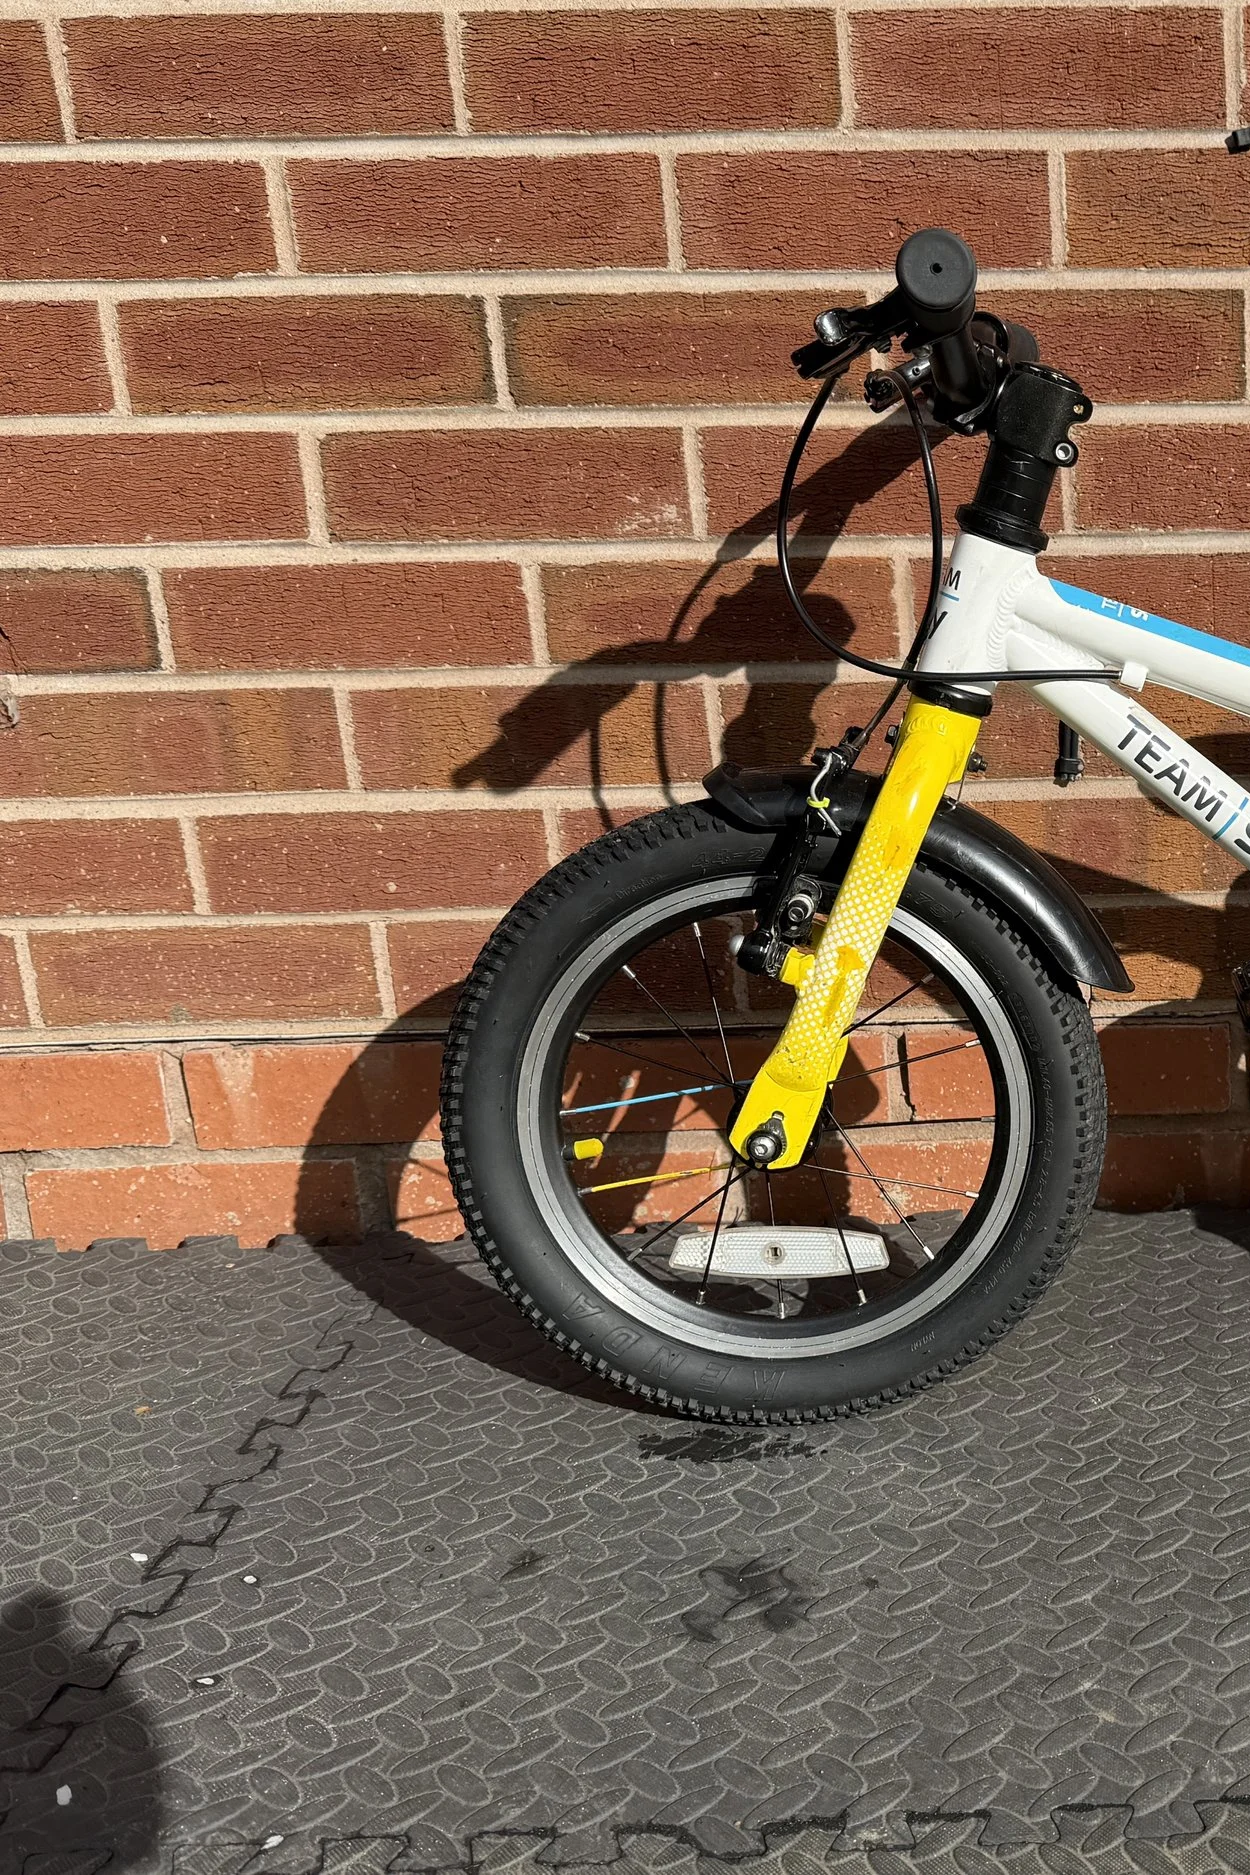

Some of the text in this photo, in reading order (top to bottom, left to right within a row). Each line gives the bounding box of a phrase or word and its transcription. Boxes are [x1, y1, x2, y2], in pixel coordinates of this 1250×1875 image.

[1116, 714, 1226, 823] TEAM
[690, 847, 766, 869] 44-2
[561, 1291, 785, 1401] KENDA
